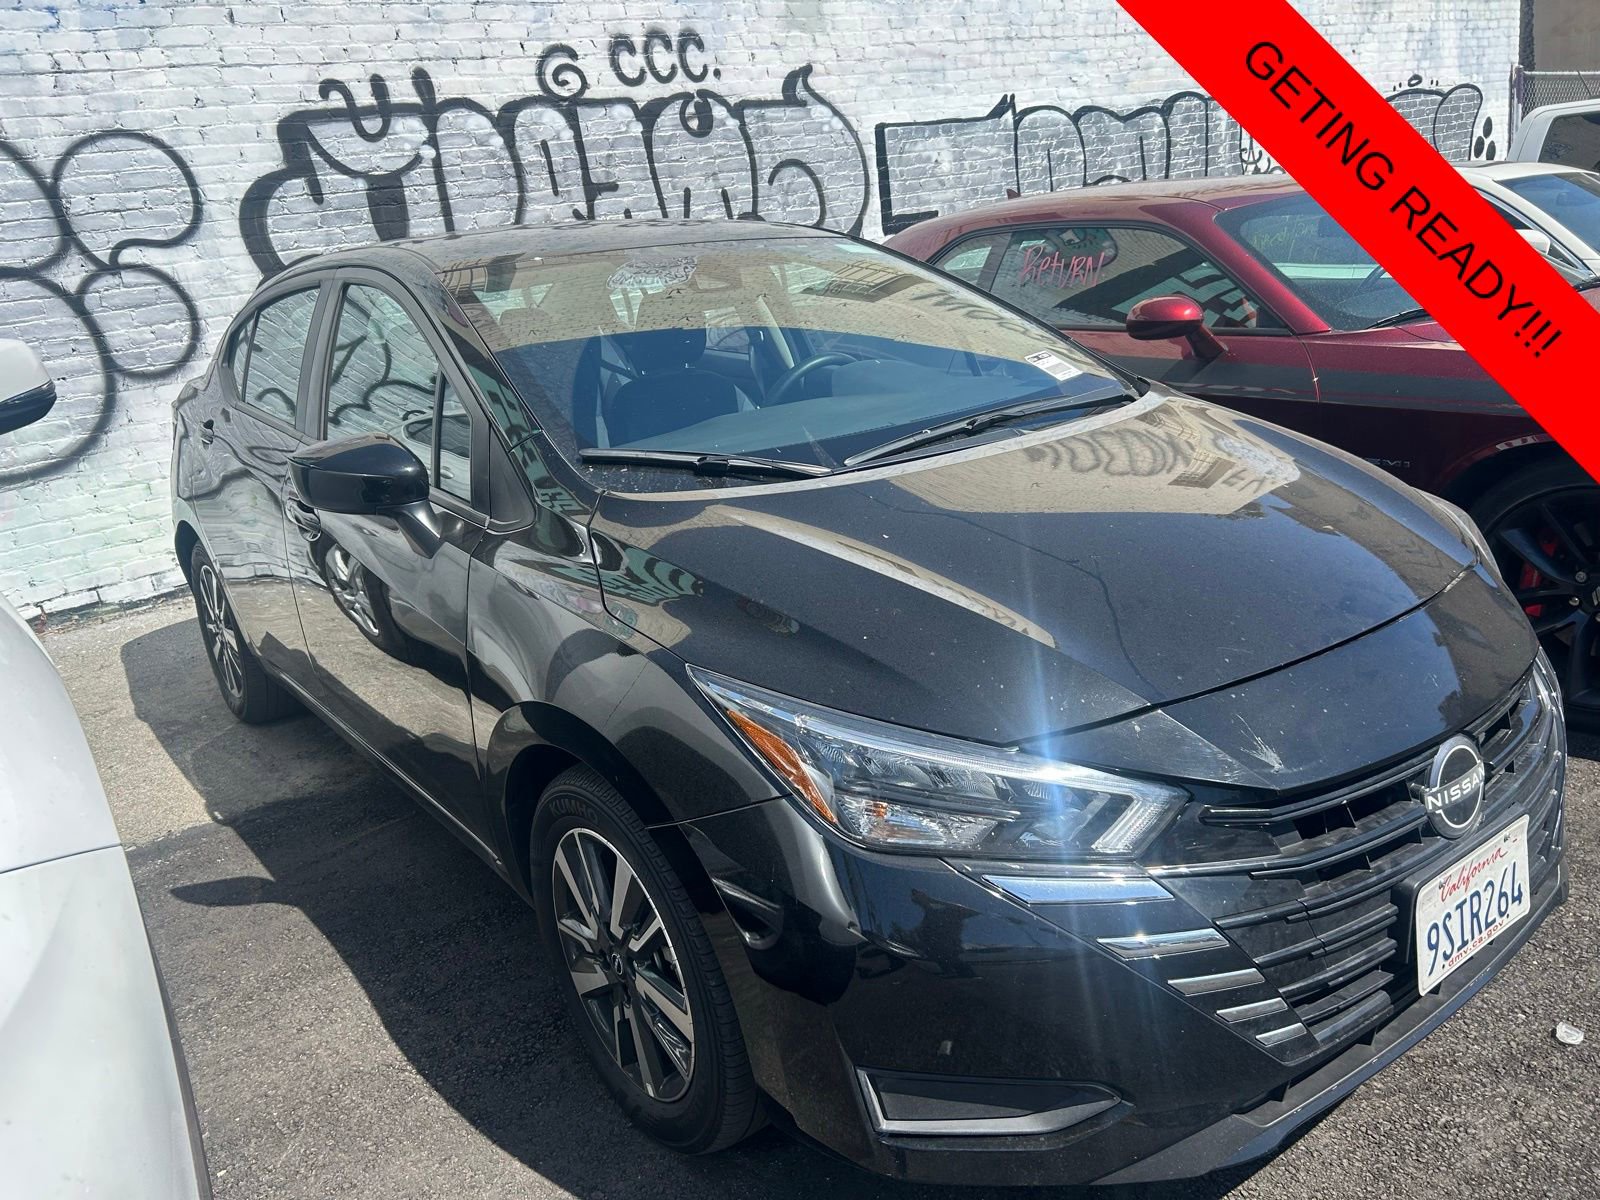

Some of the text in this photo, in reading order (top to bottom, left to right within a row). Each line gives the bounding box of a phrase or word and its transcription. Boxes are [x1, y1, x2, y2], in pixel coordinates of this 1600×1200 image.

[550, 799, 599, 825] KUMHO
[1427, 766, 1486, 811] NISSAN
[1440, 847, 1508, 903] California
[1427, 861, 1523, 977] 9SIR264
[1448, 919, 1505, 967] dmv.ca.gov
